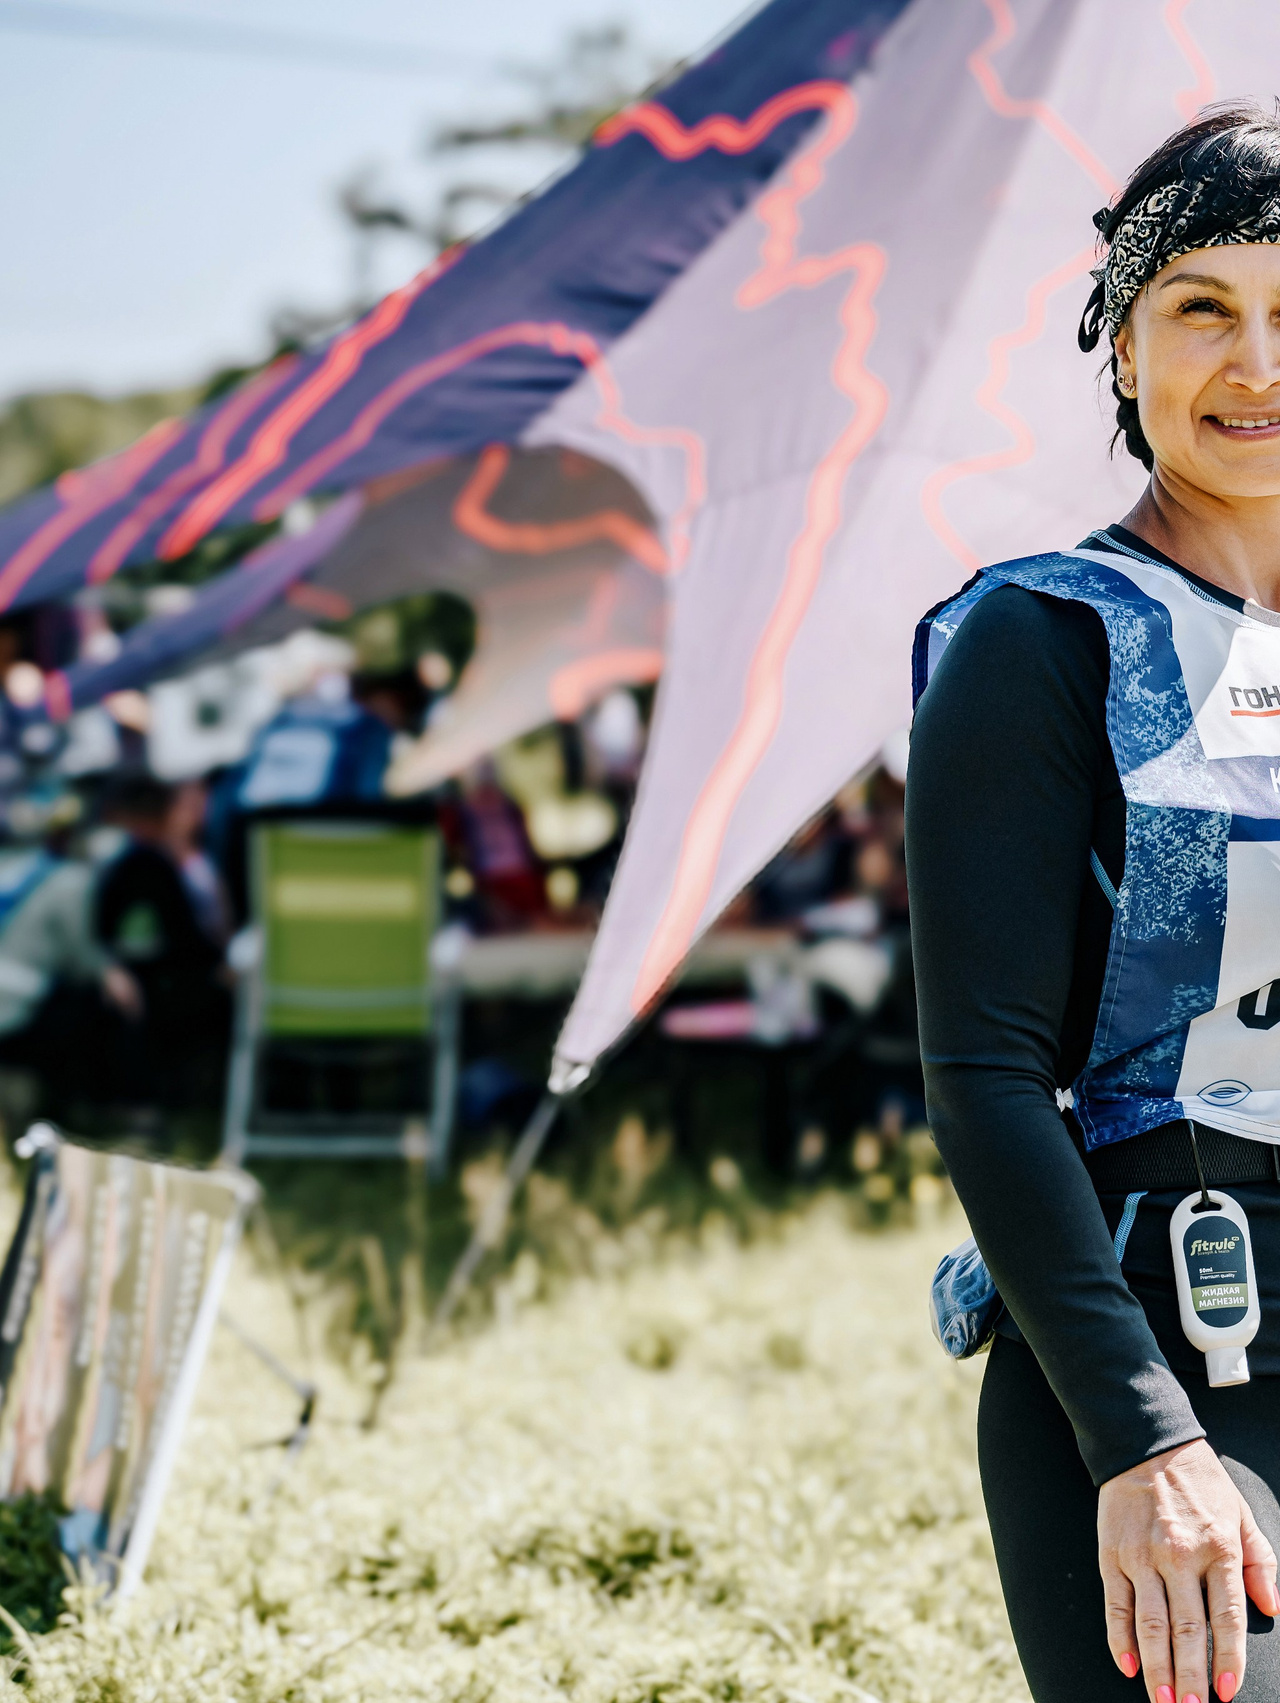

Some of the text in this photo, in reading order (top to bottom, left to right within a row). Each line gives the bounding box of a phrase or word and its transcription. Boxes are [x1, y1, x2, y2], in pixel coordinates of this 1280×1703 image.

[1190, 1237, 1236, 1256] fitrule
[1201, 1286, 1240, 1297] ЖИДКАЯ
[1199, 1296, 1244, 1308] МАГНЕЗИЯ
